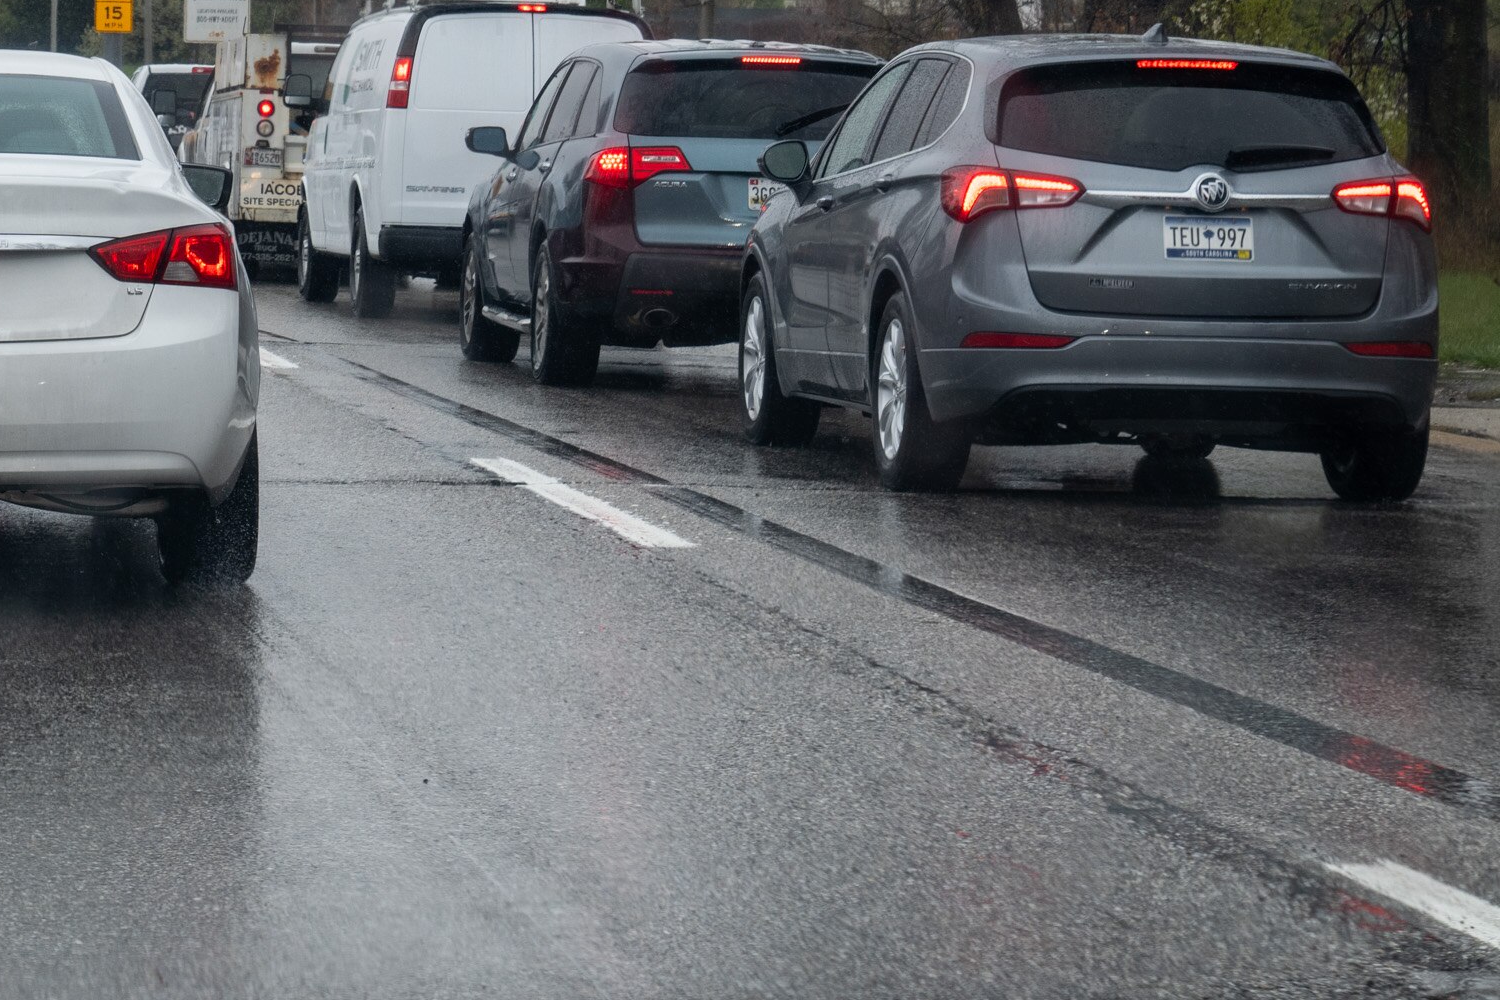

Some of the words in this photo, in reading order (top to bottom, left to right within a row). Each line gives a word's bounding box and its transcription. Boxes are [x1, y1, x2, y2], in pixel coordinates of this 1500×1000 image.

[105, 6, 123, 20] 15
[243, 197, 263, 205] SITE
[266, 197, 302, 207] SPECIA
[237, 231, 293, 246] DEJANA
[1170, 227, 1200, 247] TEU
[1217, 228, 1247, 248] 997
[1205, 250, 1233, 258] CAROLINA
[128, 287, 144, 295] LS
